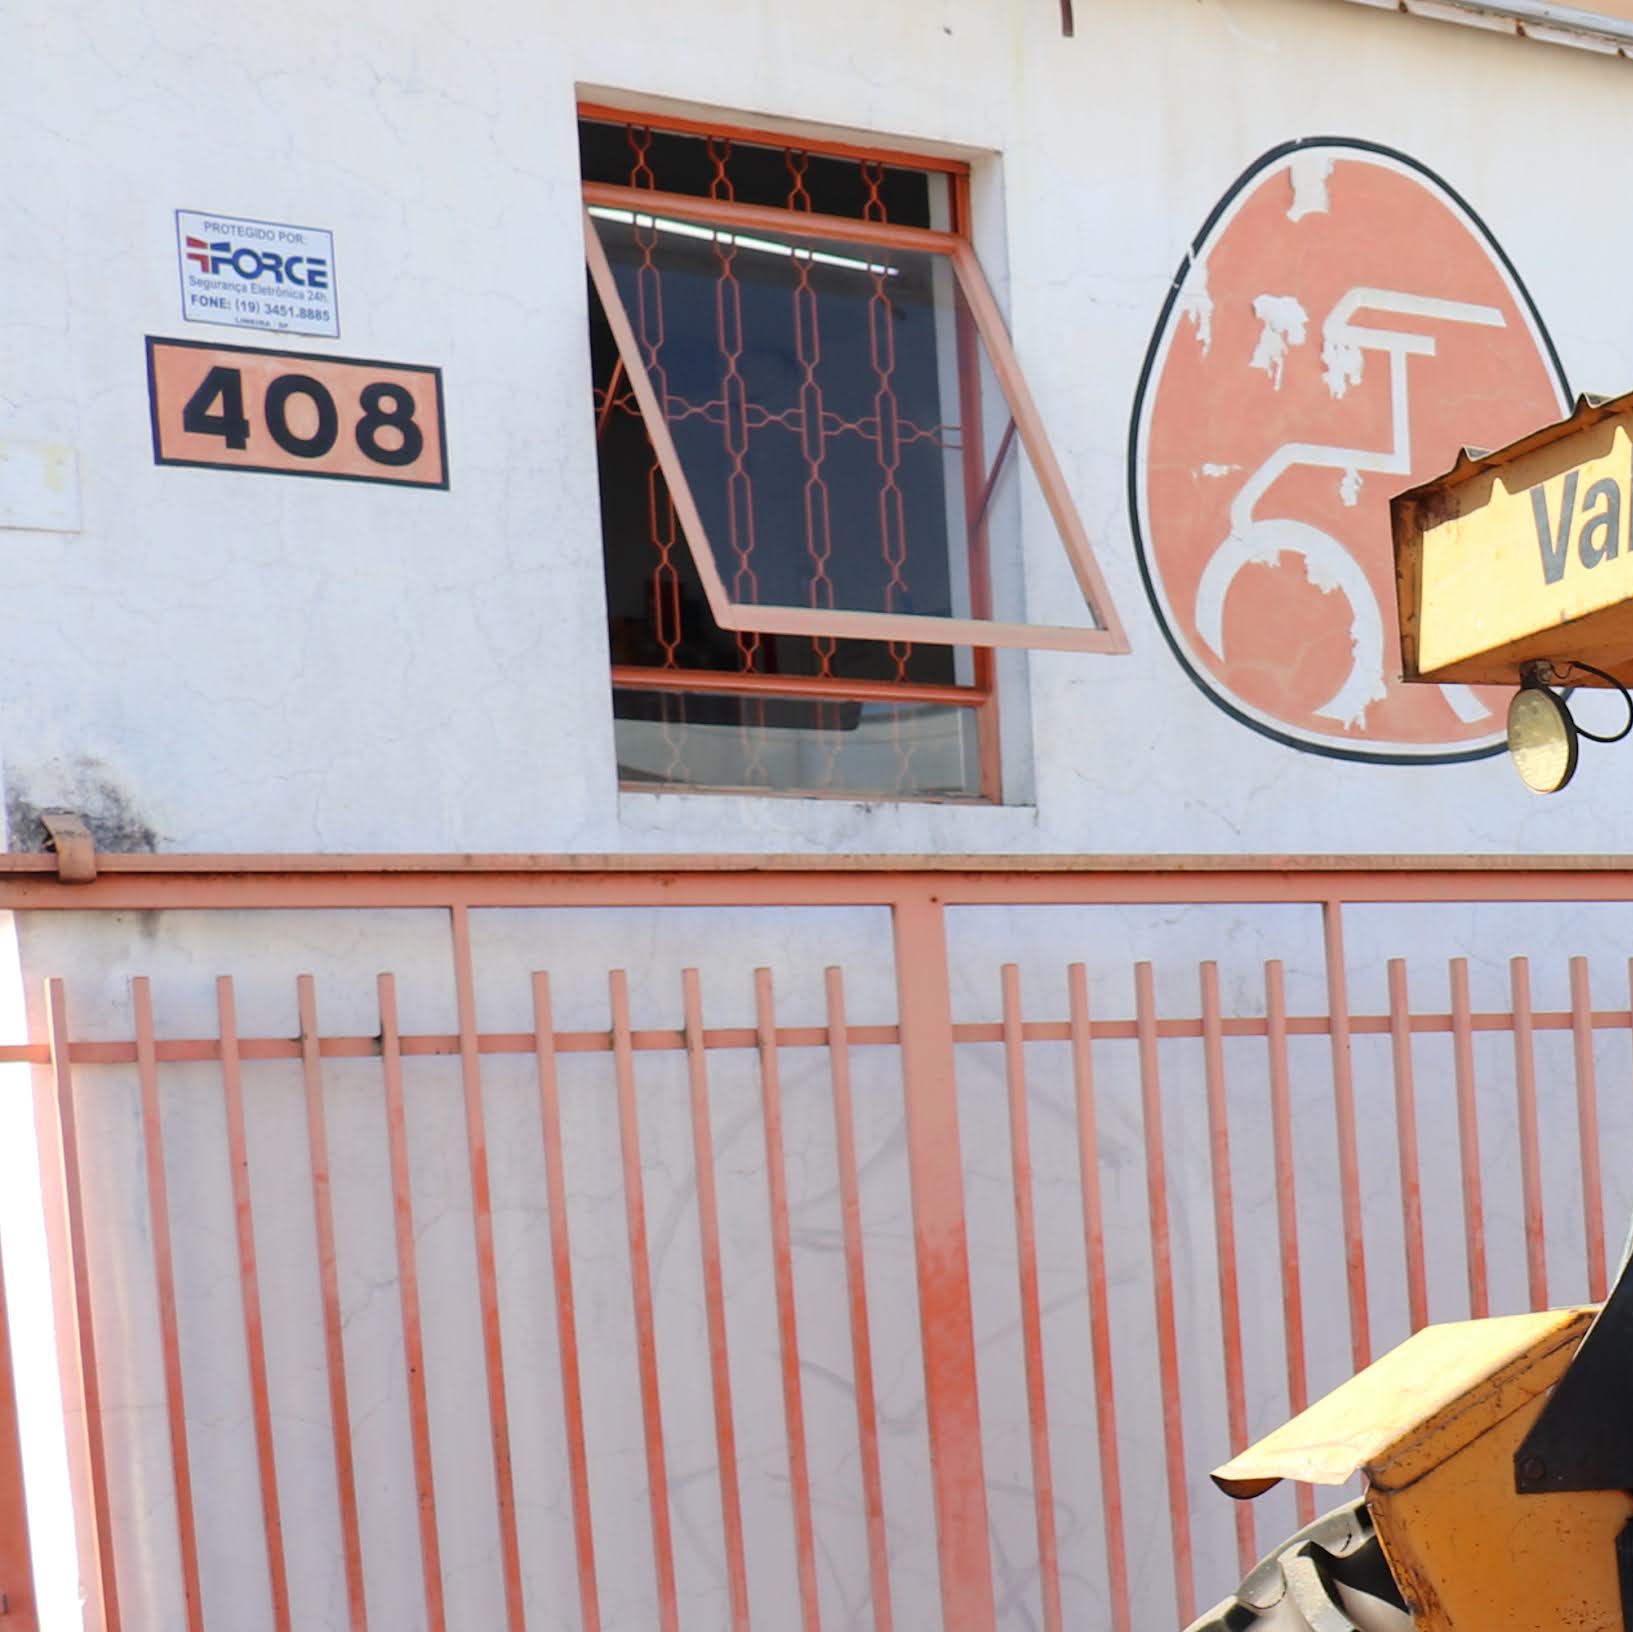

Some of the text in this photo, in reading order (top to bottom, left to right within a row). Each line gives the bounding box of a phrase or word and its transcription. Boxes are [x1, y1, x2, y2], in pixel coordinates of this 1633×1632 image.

[203, 220, 276, 242] PROTEGIDO
[209, 241, 328, 290] FORCE
[235, 298, 261, 315] (19)
[182, 365, 424, 467] 408
